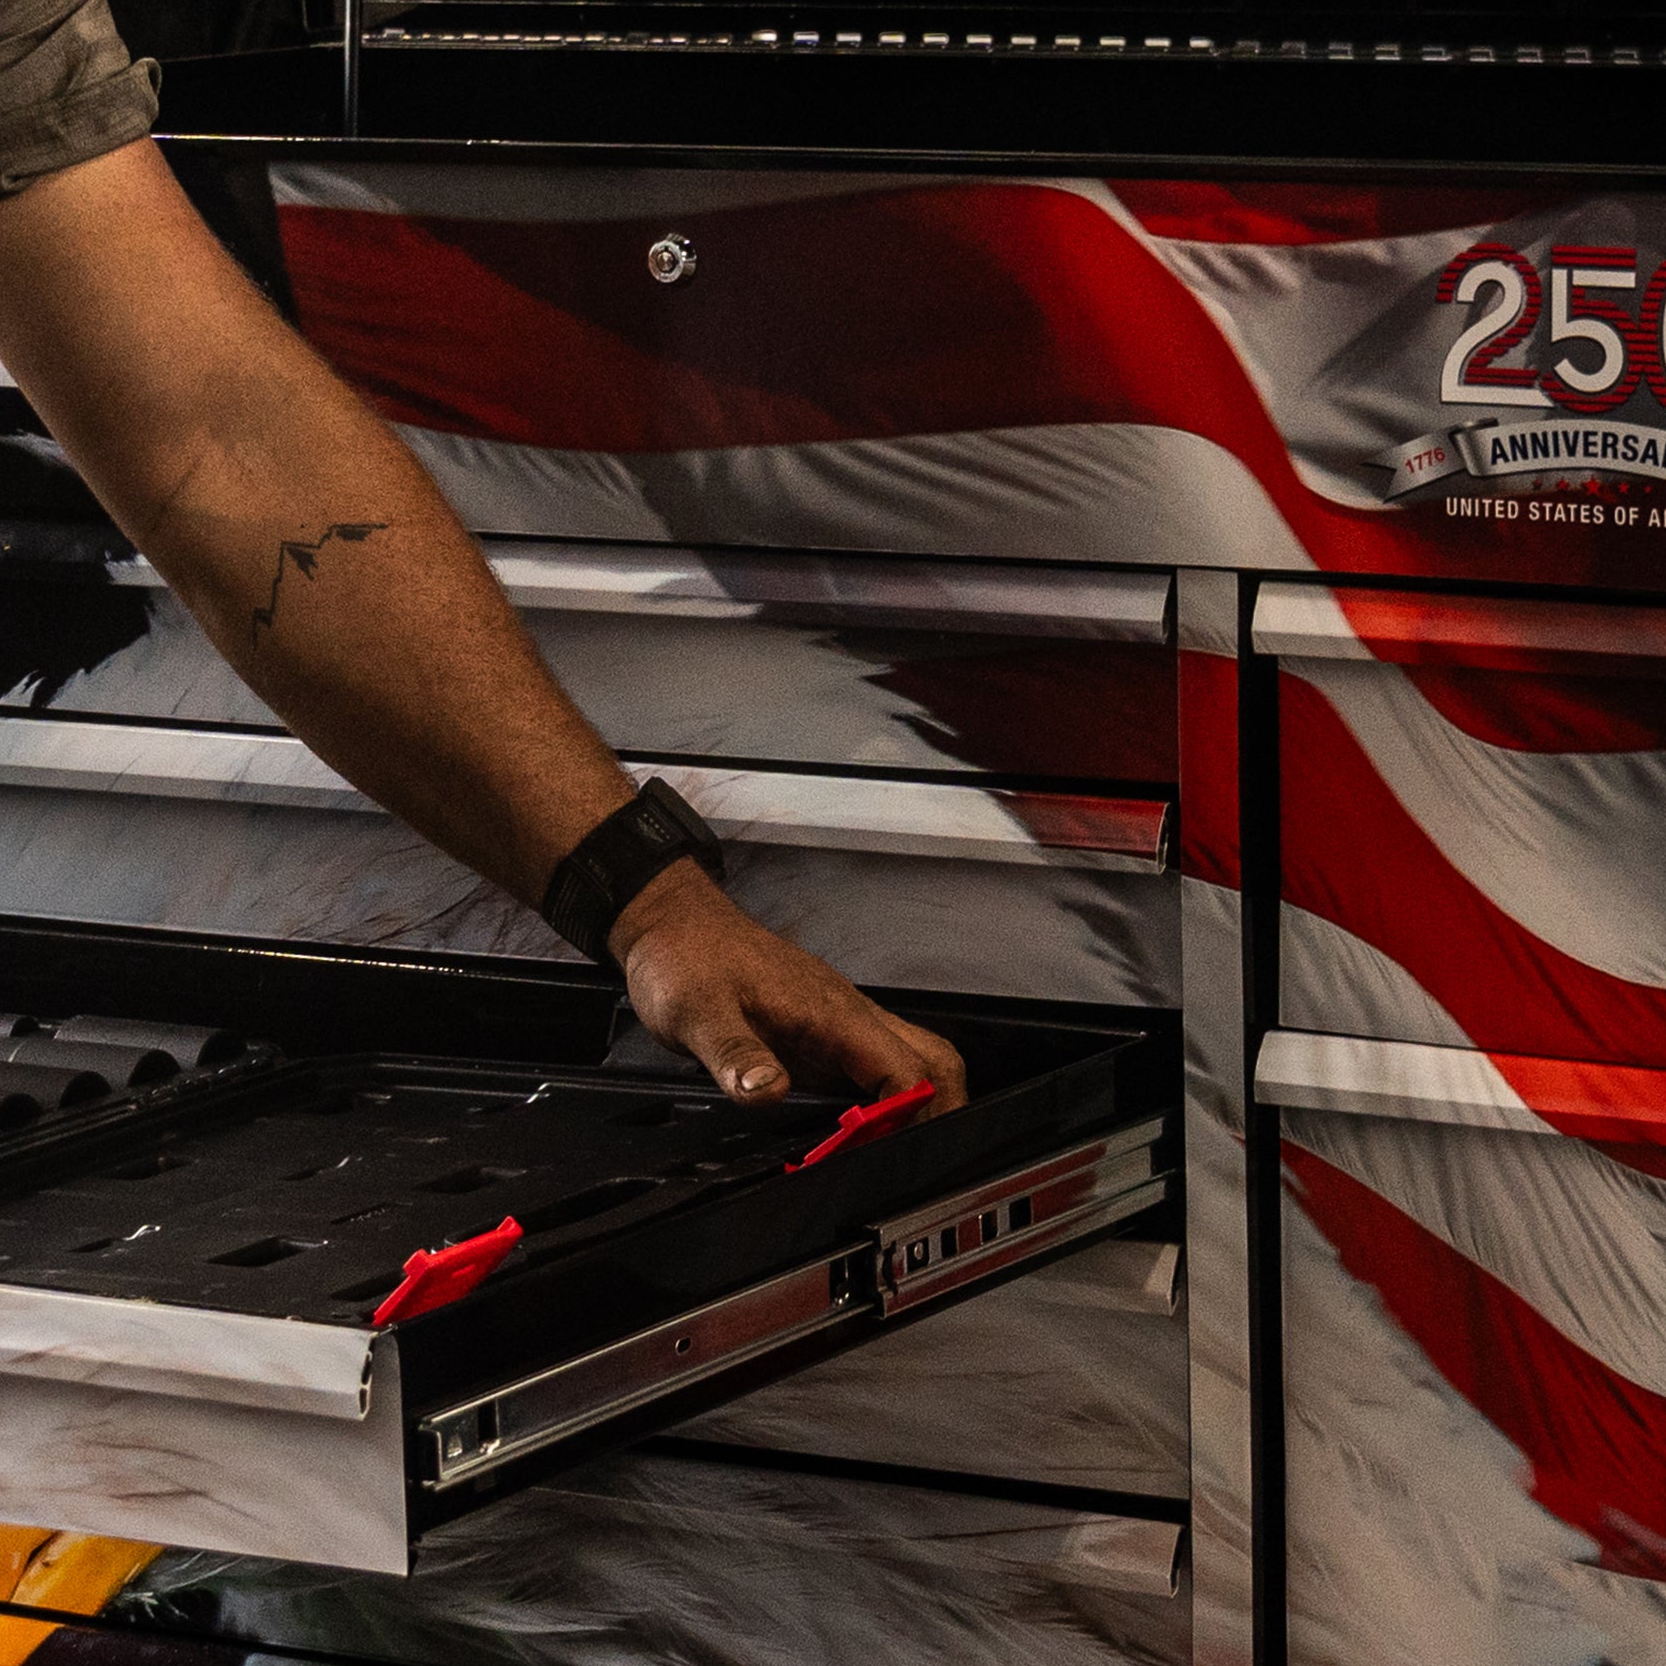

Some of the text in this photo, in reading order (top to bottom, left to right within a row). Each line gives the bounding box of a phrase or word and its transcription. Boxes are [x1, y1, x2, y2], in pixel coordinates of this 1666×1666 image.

[1404, 446, 1447, 474] 1776
[1445, 496, 1520, 520] UNITED
[1528, 501, 1605, 525] STATES
[1614, 506, 1640, 527] OF
